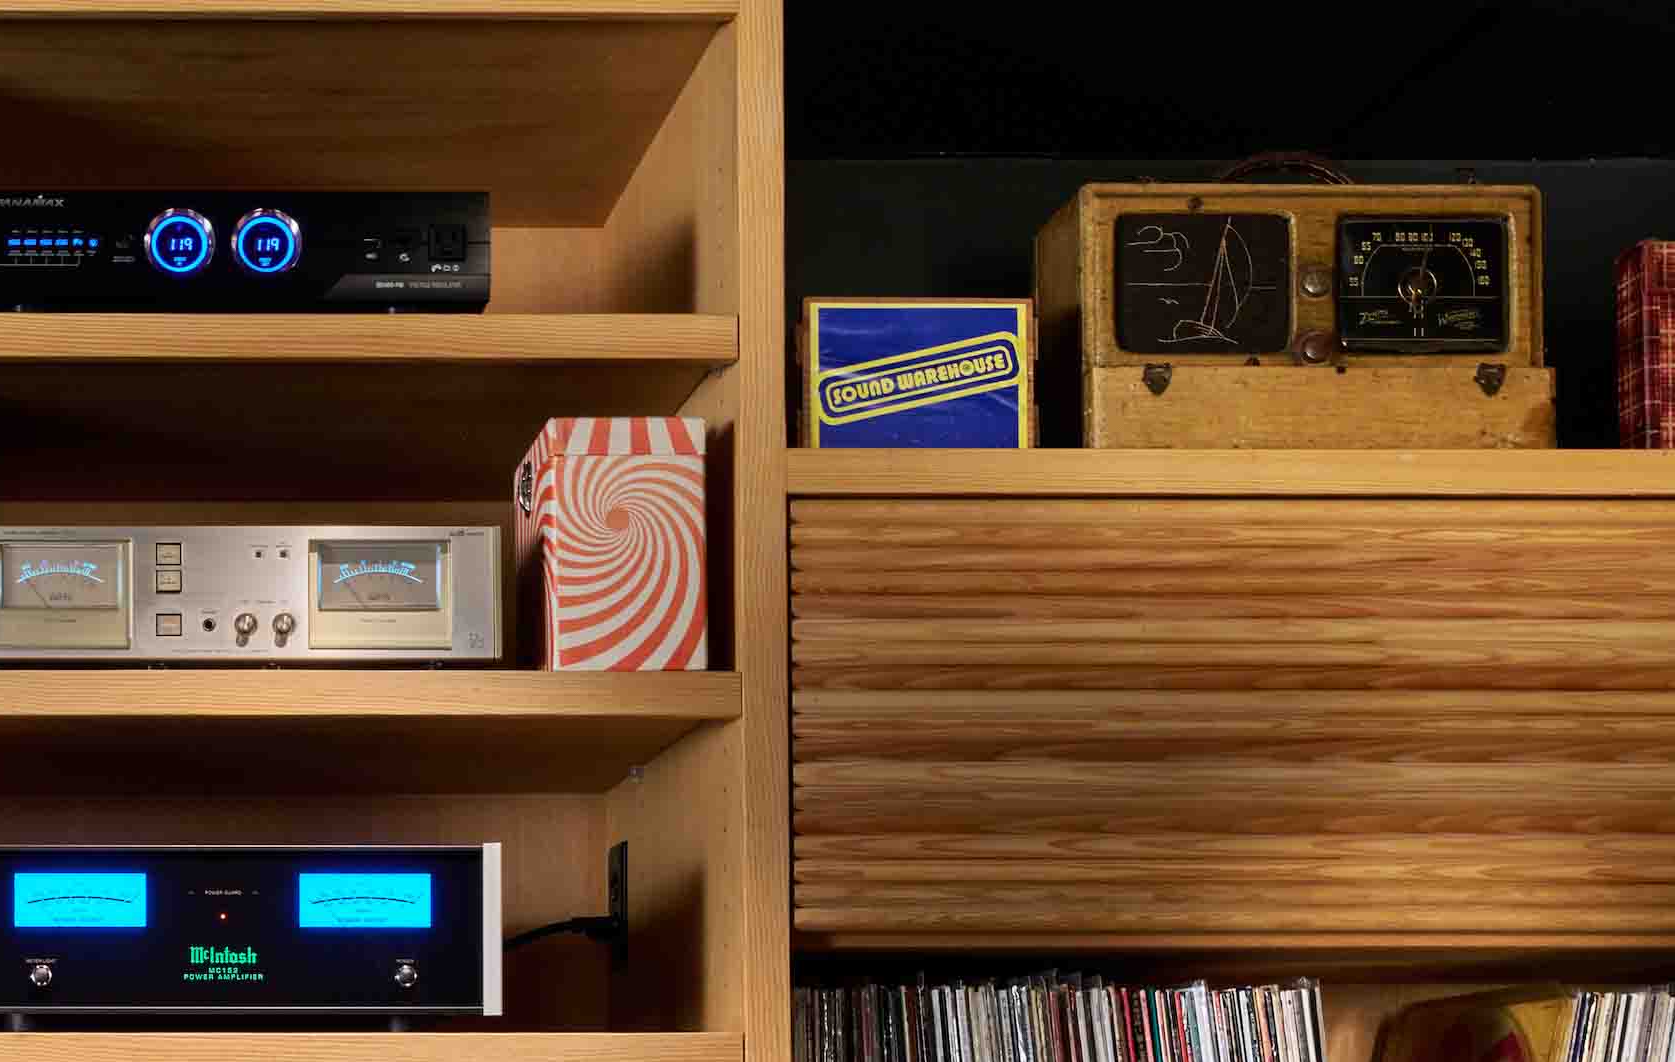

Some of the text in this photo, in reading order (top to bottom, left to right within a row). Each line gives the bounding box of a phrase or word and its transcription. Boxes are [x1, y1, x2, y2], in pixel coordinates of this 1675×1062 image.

[171, 237, 193, 250] 119
[257, 238, 280, 251] 119
[832, 353, 1006, 406] SOUND WAREHOUSE
[190, 945, 258, 964] McIntosh
